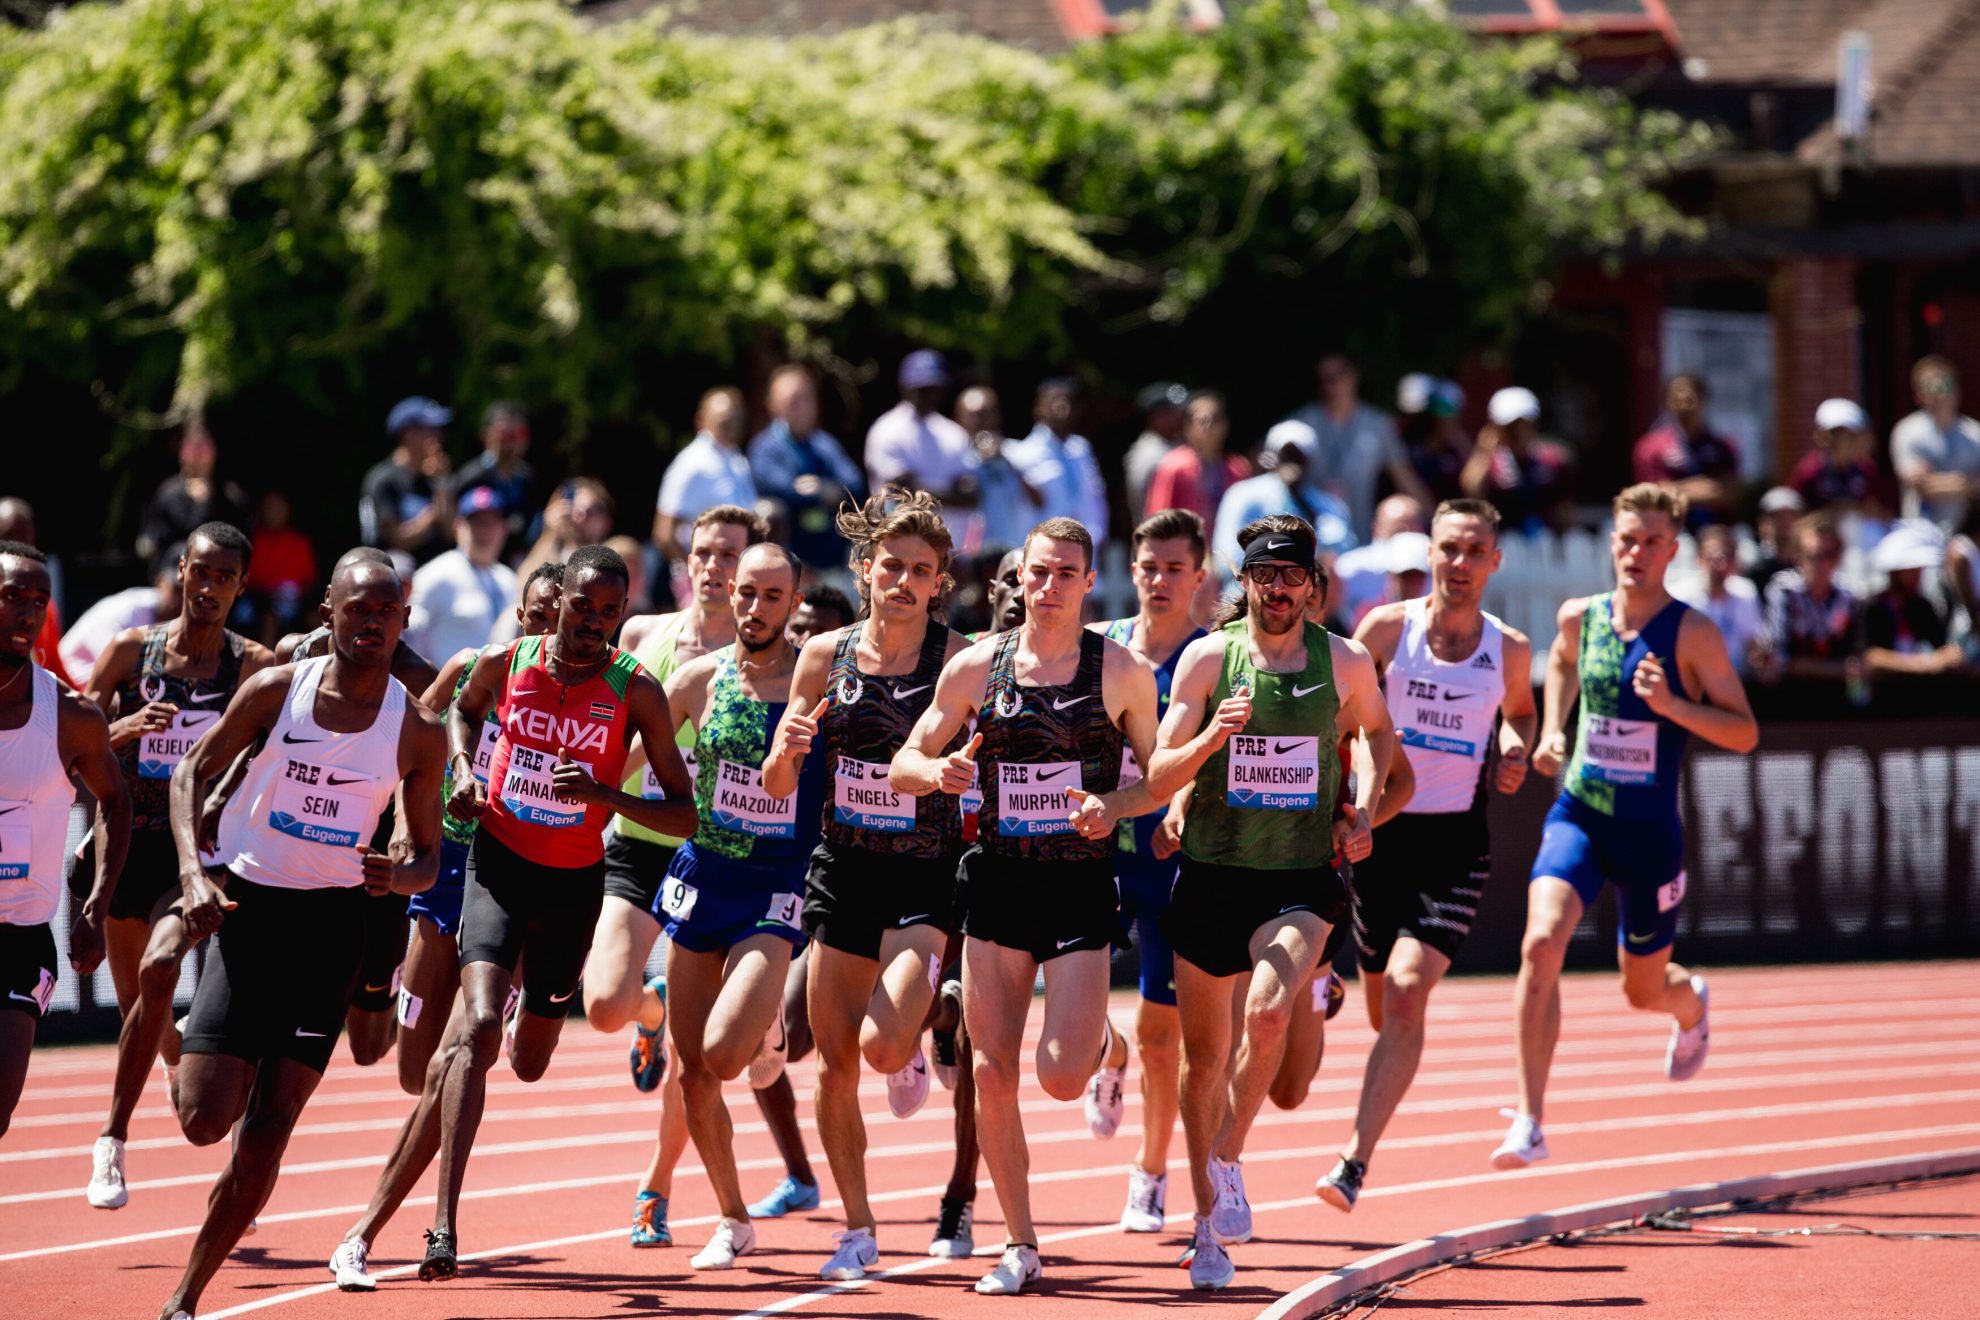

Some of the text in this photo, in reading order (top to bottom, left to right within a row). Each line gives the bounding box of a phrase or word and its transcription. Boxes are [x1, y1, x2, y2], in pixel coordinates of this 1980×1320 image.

[1407, 680, 1437, 700] PRE
[506, 703, 609, 755] KENYA
[1417, 708, 1464, 730] WILLIS
[1236, 737, 1266, 756] PRE
[1424, 735, 1469, 753] Eugene
[515, 747, 544, 772] PRE
[841, 758, 863, 780] PRE
[285, 759, 321, 786] PRE
[723, 763, 750, 787] PRE
[1003, 766, 1028, 784] PRE
[1235, 765, 1313, 784] BLANKENSHIP
[302, 796, 340, 818] SEIN
[721, 789, 790, 815] KAAZOUZI
[847, 787, 900, 807] ENGELS
[1009, 793, 1070, 811] MURPHY
[1262, 794, 1309, 807] Eugene
[531, 808, 577, 826] Eugene
[862, 814, 907, 829] Eugene
[302, 825, 352, 845] Eugene
[741, 820, 786, 836] Eugene
[672, 884, 686, 909] 9
